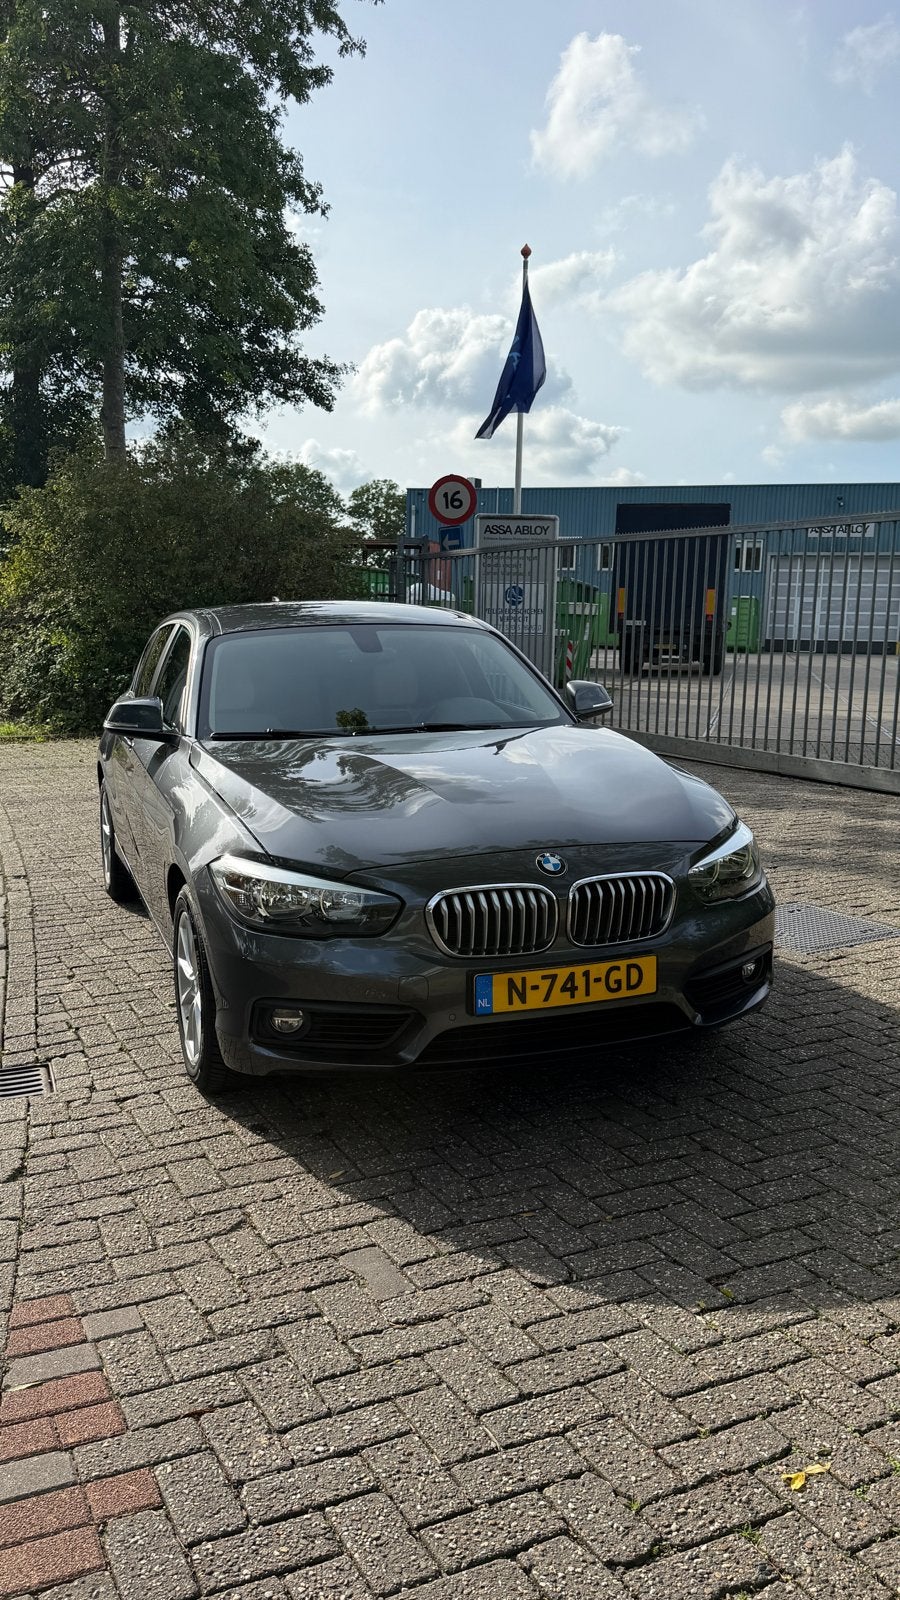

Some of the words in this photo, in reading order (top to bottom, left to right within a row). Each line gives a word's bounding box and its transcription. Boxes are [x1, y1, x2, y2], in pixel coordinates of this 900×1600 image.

[443, 490, 463, 509] 16
[484, 524, 512, 535] ASSA
[514, 525, 550, 535] ABLOY
[478, 999, 491, 1008] NL
[507, 963, 644, 1006] N-741-GD
